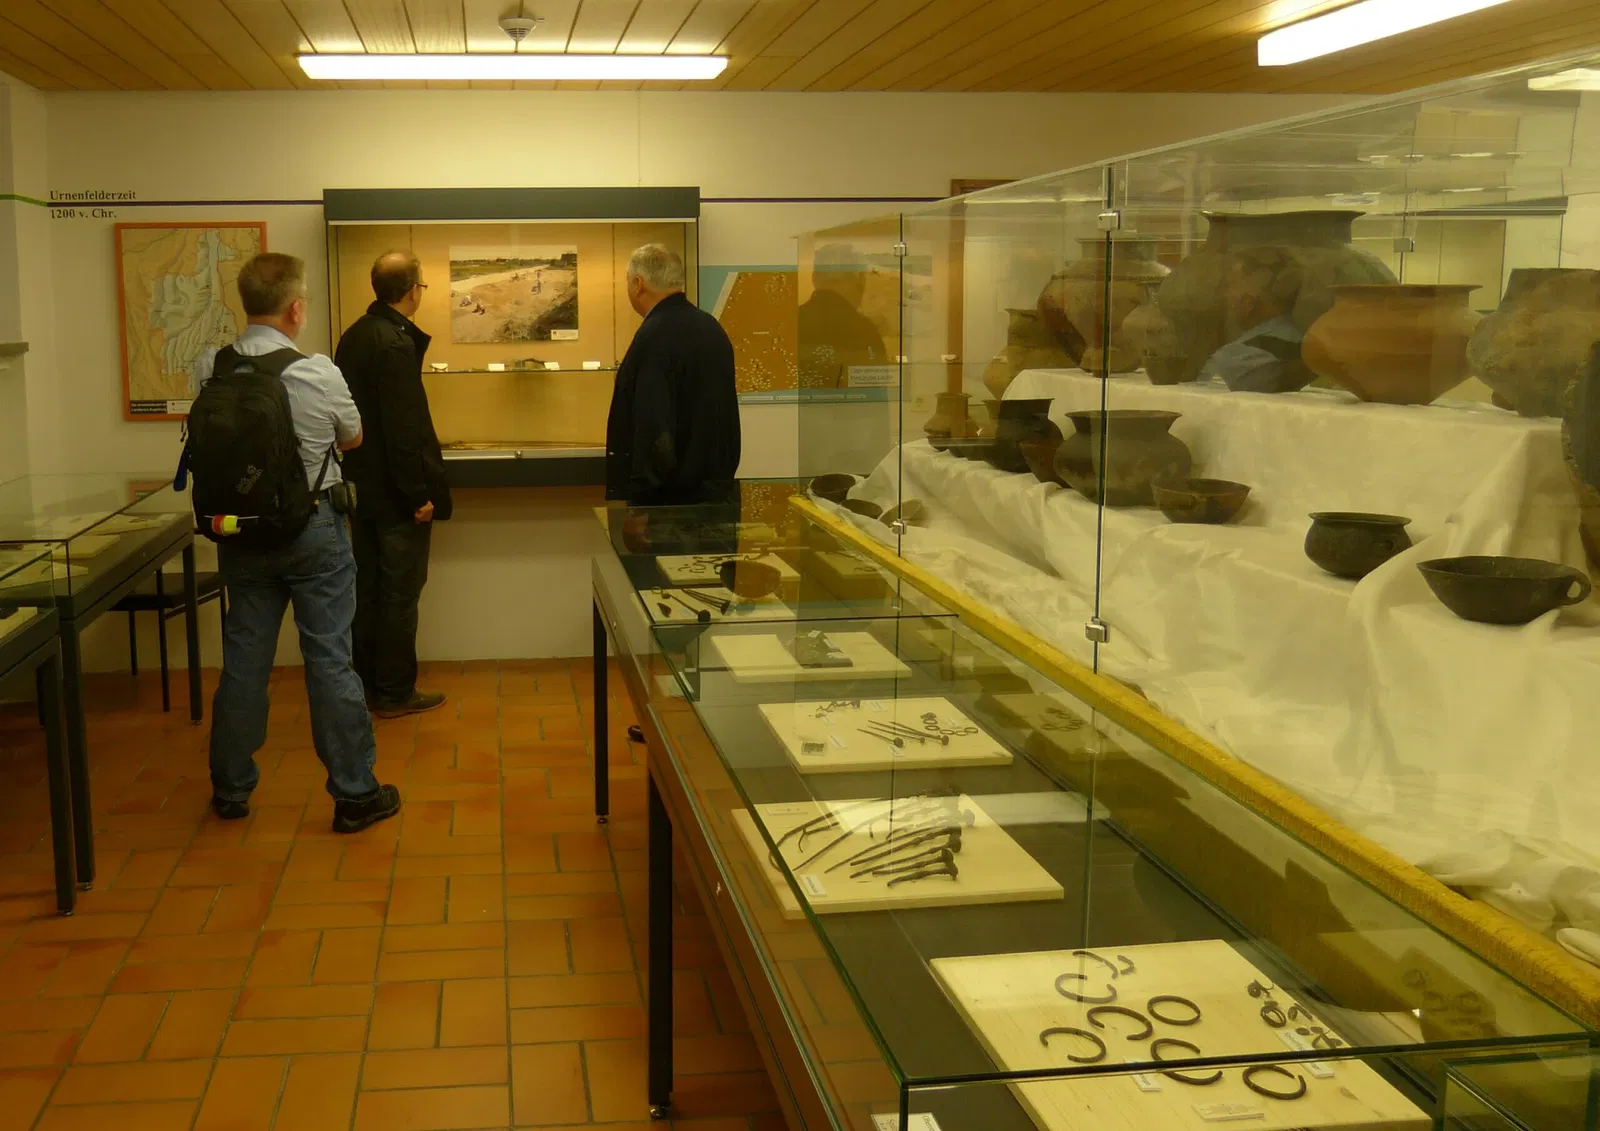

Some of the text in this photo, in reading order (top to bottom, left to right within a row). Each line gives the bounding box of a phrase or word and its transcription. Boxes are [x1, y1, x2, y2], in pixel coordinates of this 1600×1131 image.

[50, 190, 136, 200] Urnenfelderzeit
[51, 209, 75, 219] 1200
[92, 208, 117, 218] Chr.
